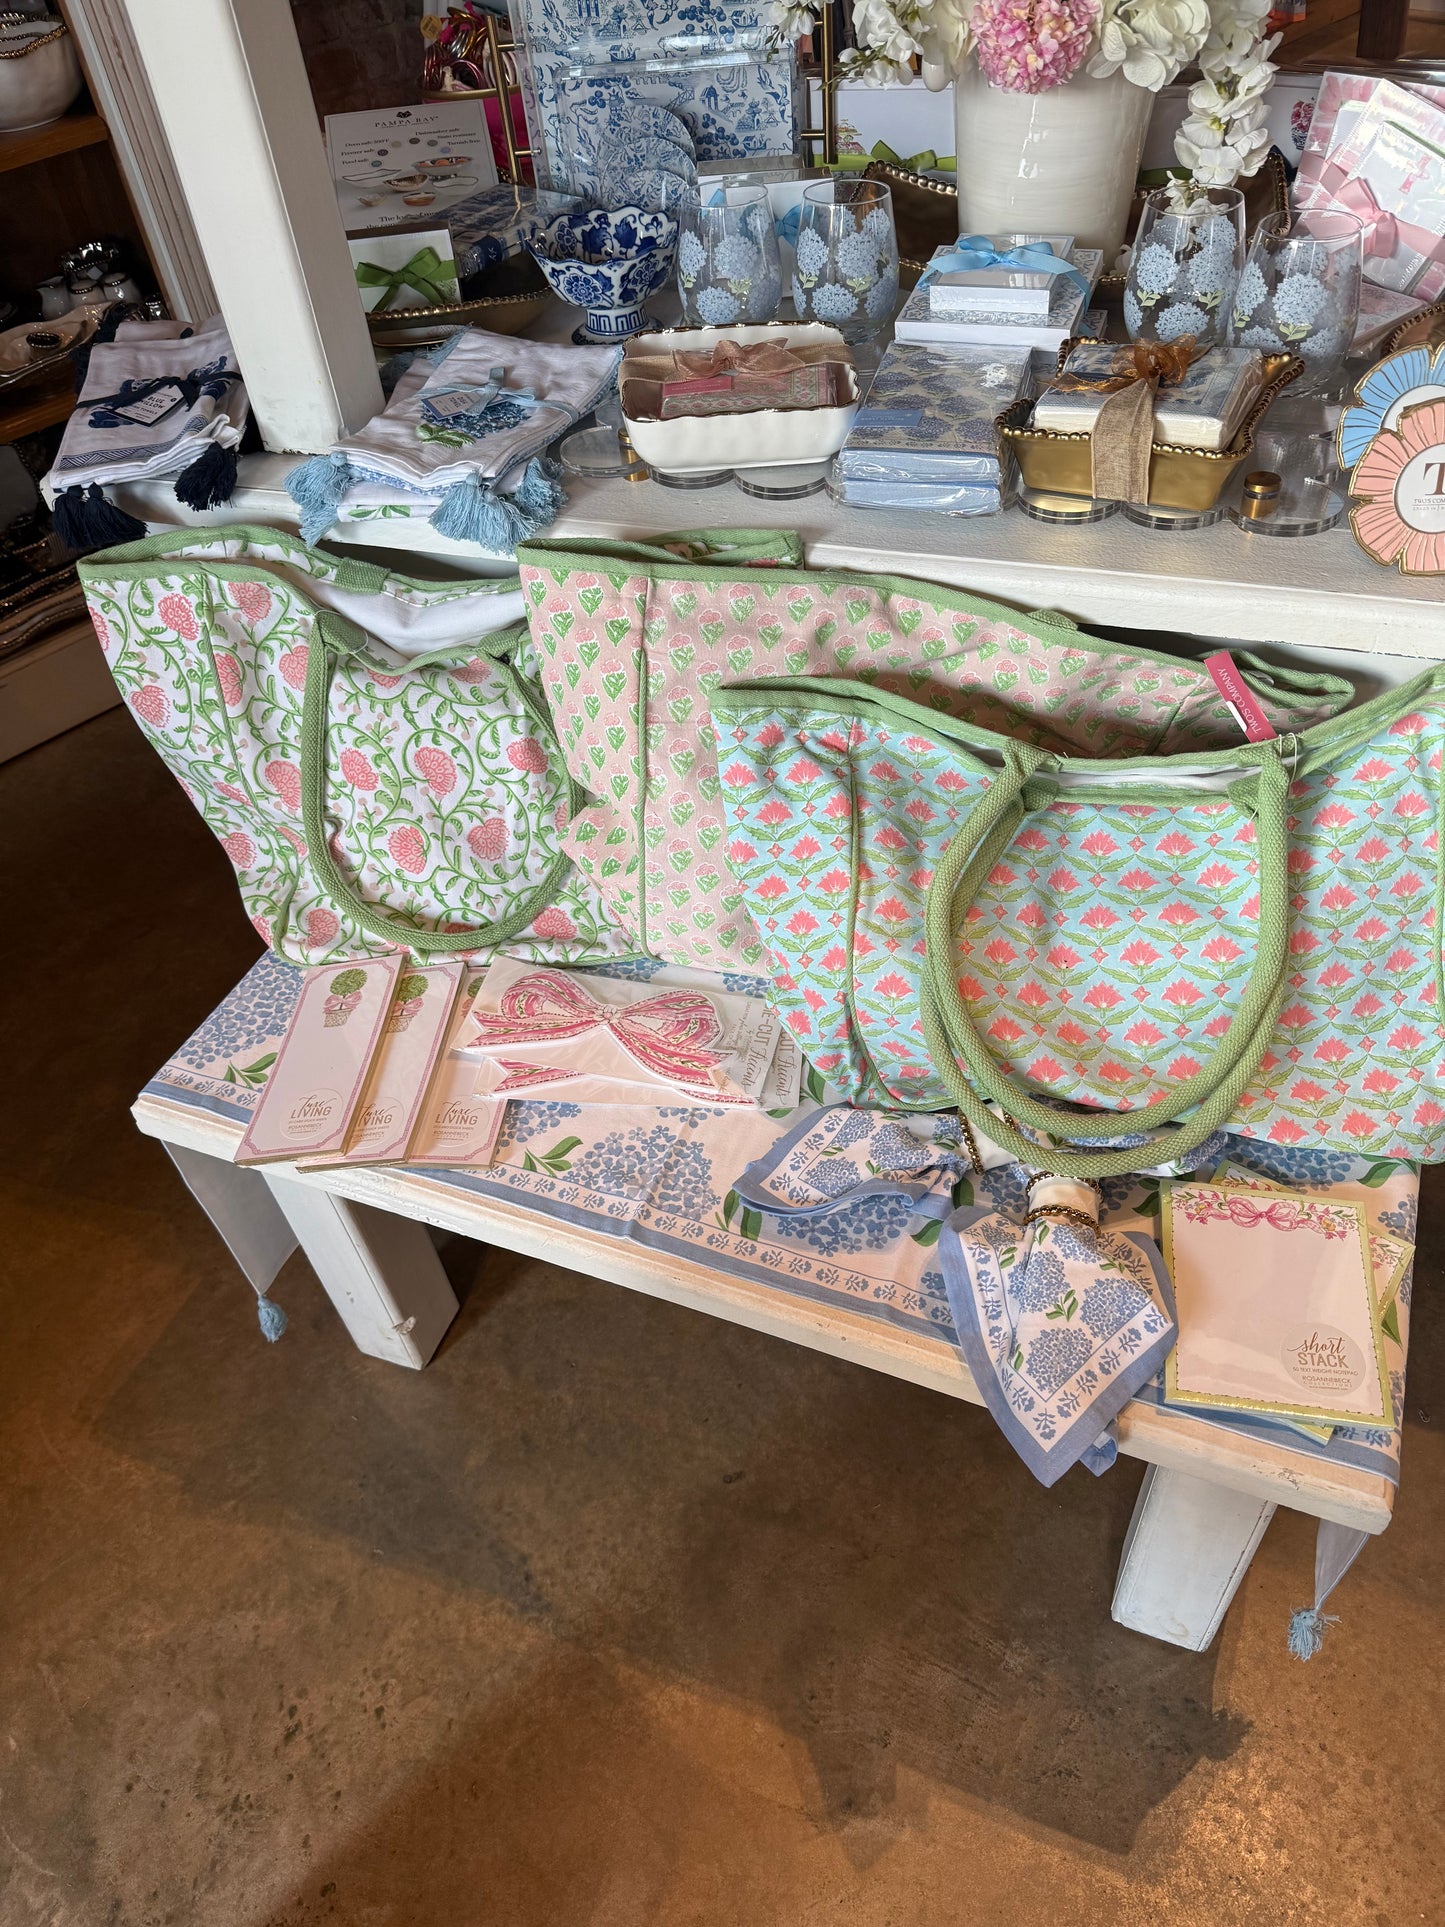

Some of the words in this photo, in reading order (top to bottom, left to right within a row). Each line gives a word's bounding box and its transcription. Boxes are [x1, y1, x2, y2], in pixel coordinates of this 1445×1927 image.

[375, 119, 411, 127] PAMPA
[379, 215, 396, 223] The
[140, 400, 165, 409] ILLOW
[147, 396, 165, 404] BLUE
[1217, 668, 1245, 708] COMPANY
[741, 1047, 767, 1094] Accents
[775, 1056, 797, 1105] Accents
[291, 1107, 332, 1119] LIVING
[358, 1115, 393, 1127] IVING
[435, 1114, 478, 1125] LIVING
[1287, 1331, 1345, 1354] short
[1297, 1352, 1349, 1369] STACK
